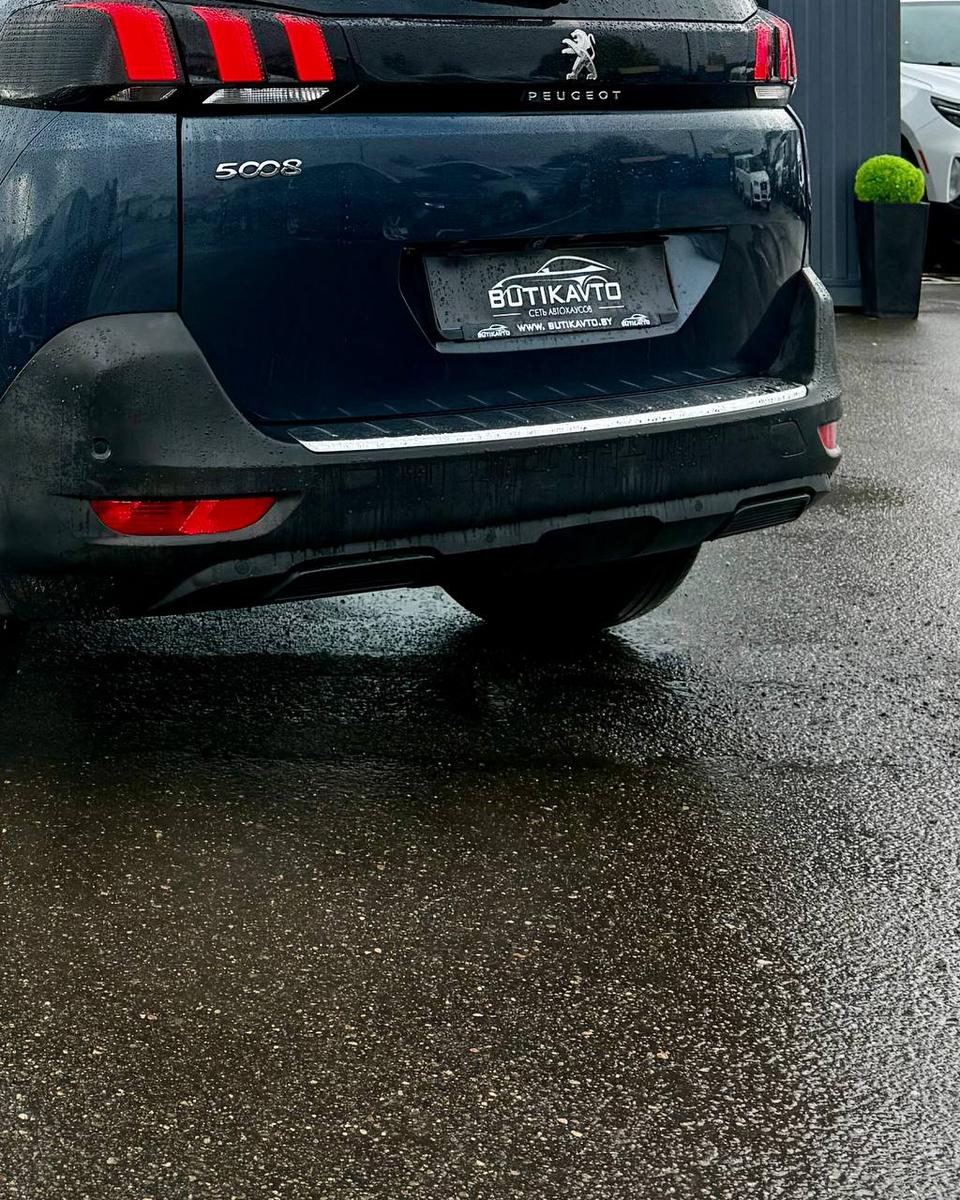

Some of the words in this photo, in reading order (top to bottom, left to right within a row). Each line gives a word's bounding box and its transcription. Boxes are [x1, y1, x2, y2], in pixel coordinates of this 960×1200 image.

[527, 89, 622, 101] PEUGEOT
[214, 158, 303, 180] 5008
[487, 281, 622, 309] BUTIKAVTO
[528, 308, 548, 318] СЕТЬ
